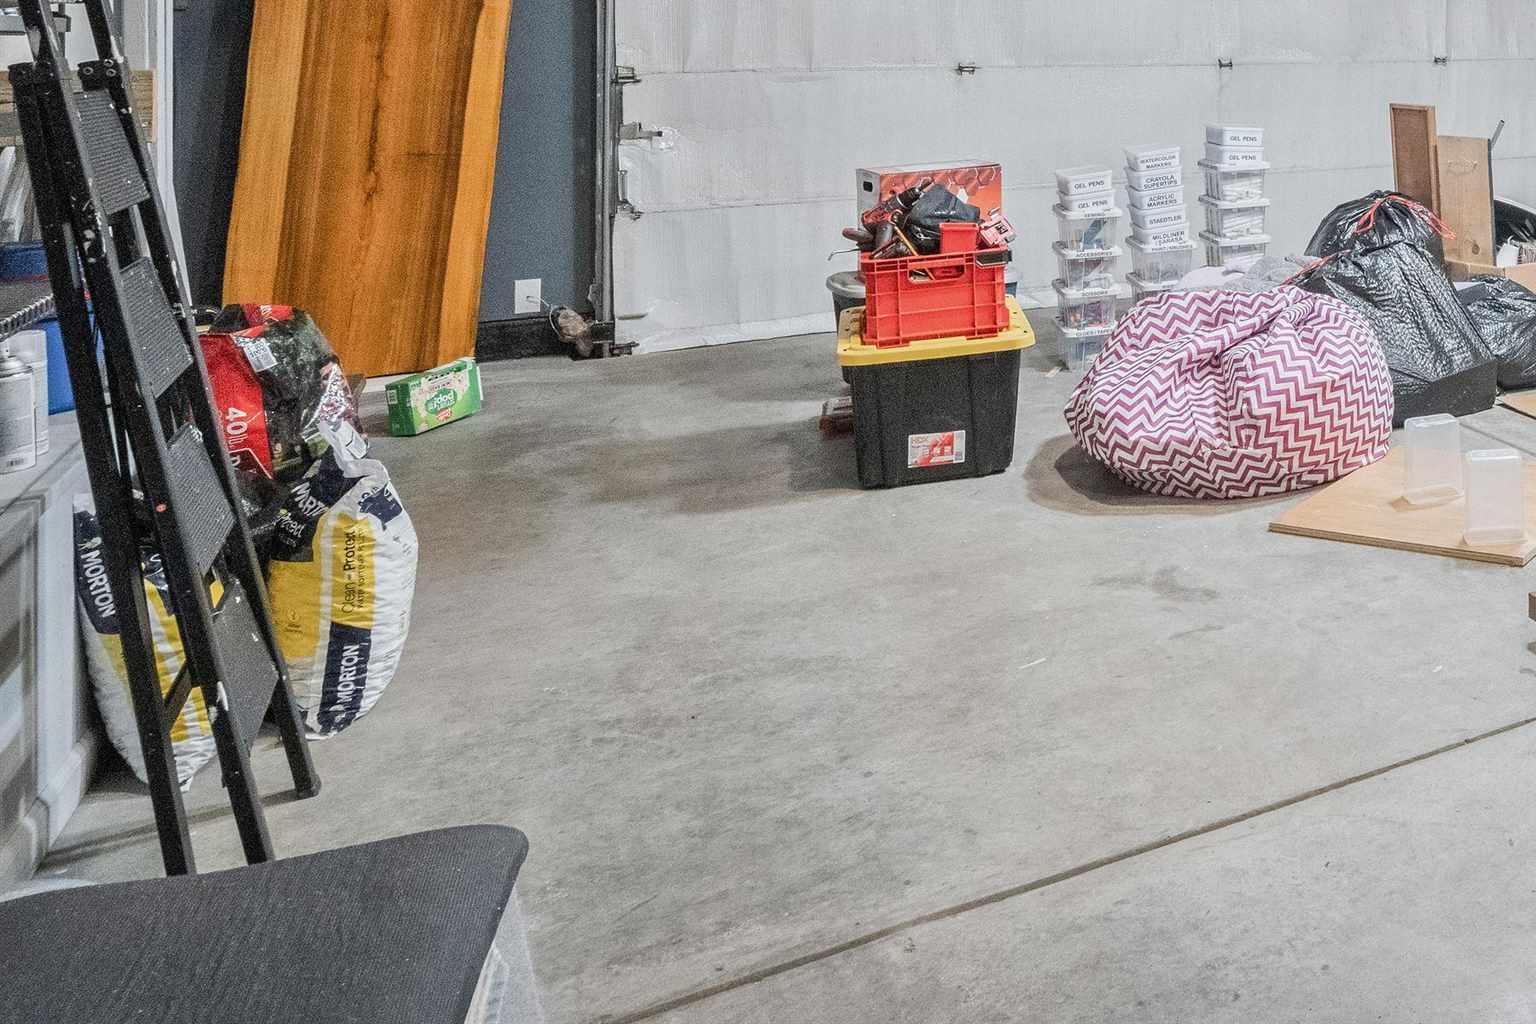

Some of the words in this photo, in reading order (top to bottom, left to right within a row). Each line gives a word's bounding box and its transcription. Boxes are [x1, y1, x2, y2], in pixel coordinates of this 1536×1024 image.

[1145, 161, 1172, 169] MARKERS
[1145, 174, 1175, 184] CRAYOLA
[1088, 180, 1105, 188] PENS
[1143, 180, 1178, 189] SUPERTIPS
[1149, 193, 1174, 202] ACRYLIC
[1147, 199, 1177, 207] MARKERS
[80, 549, 117, 618] MORTON
[341, 581, 356, 614] Clean
[336, 644, 361, 703] MORTON
